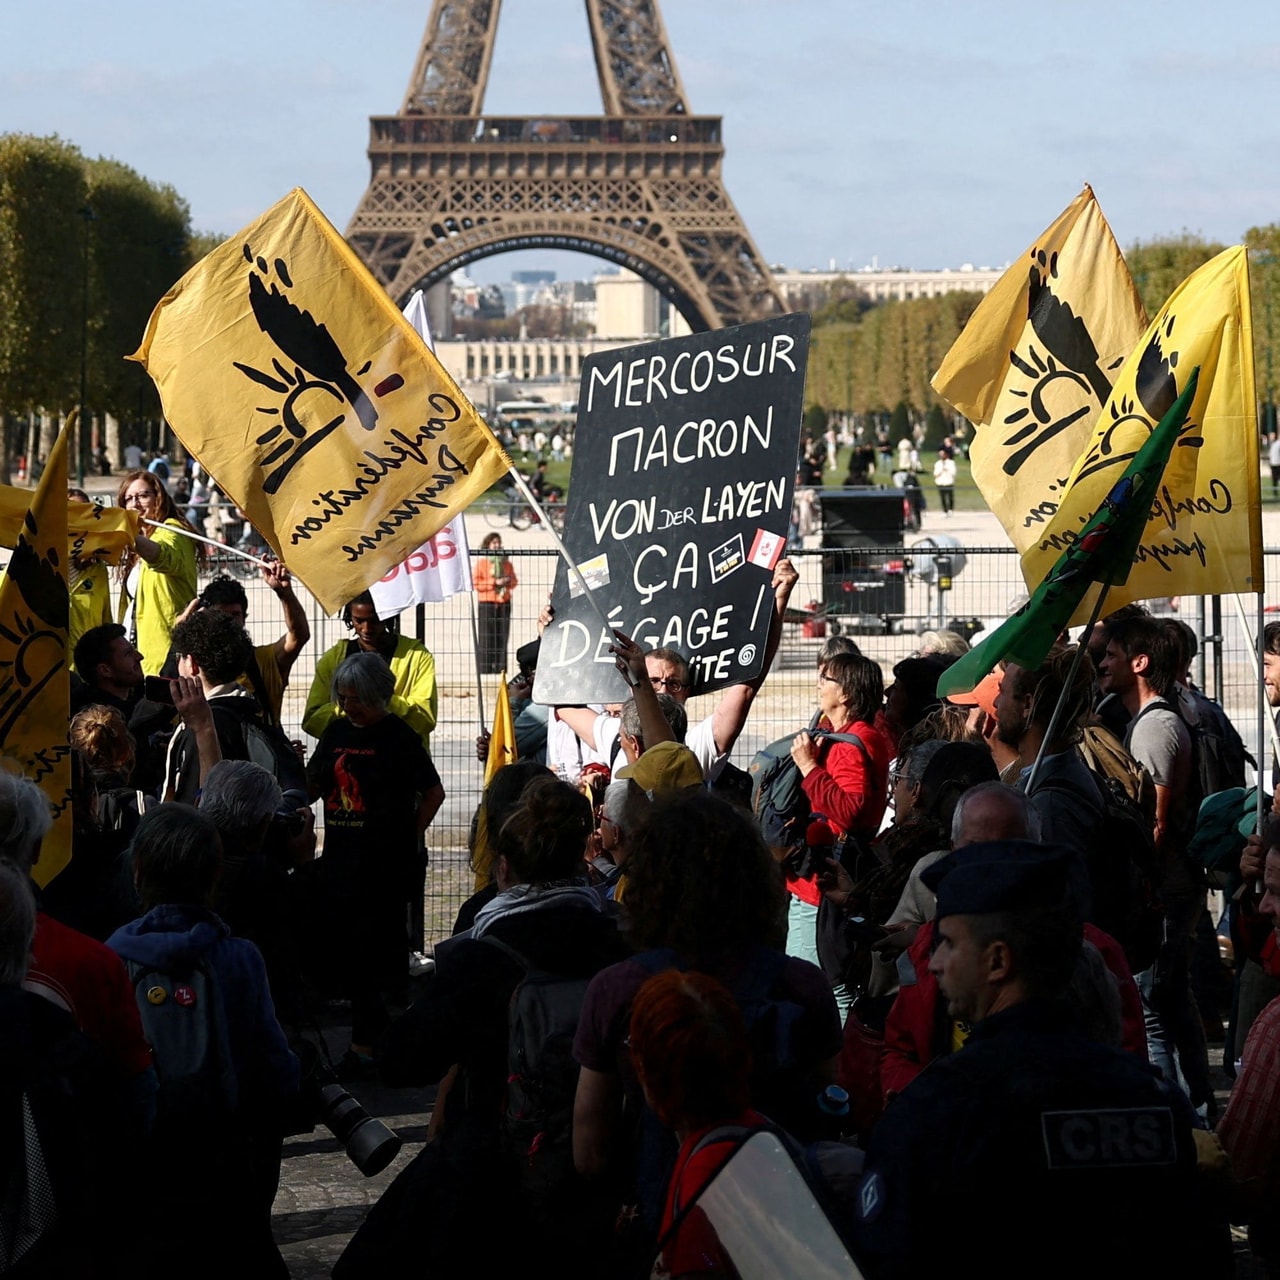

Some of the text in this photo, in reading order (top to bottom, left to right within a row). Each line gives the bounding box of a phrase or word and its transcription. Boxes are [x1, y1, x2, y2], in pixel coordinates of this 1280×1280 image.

[587, 334, 797, 413] MERCOSUR
[589, 477, 786, 545] VON DER LAYEN
[633, 542, 699, 605] ÇA
[550, 605, 734, 668] DÉGAGE
[1061, 1114, 1163, 1161] CRS
